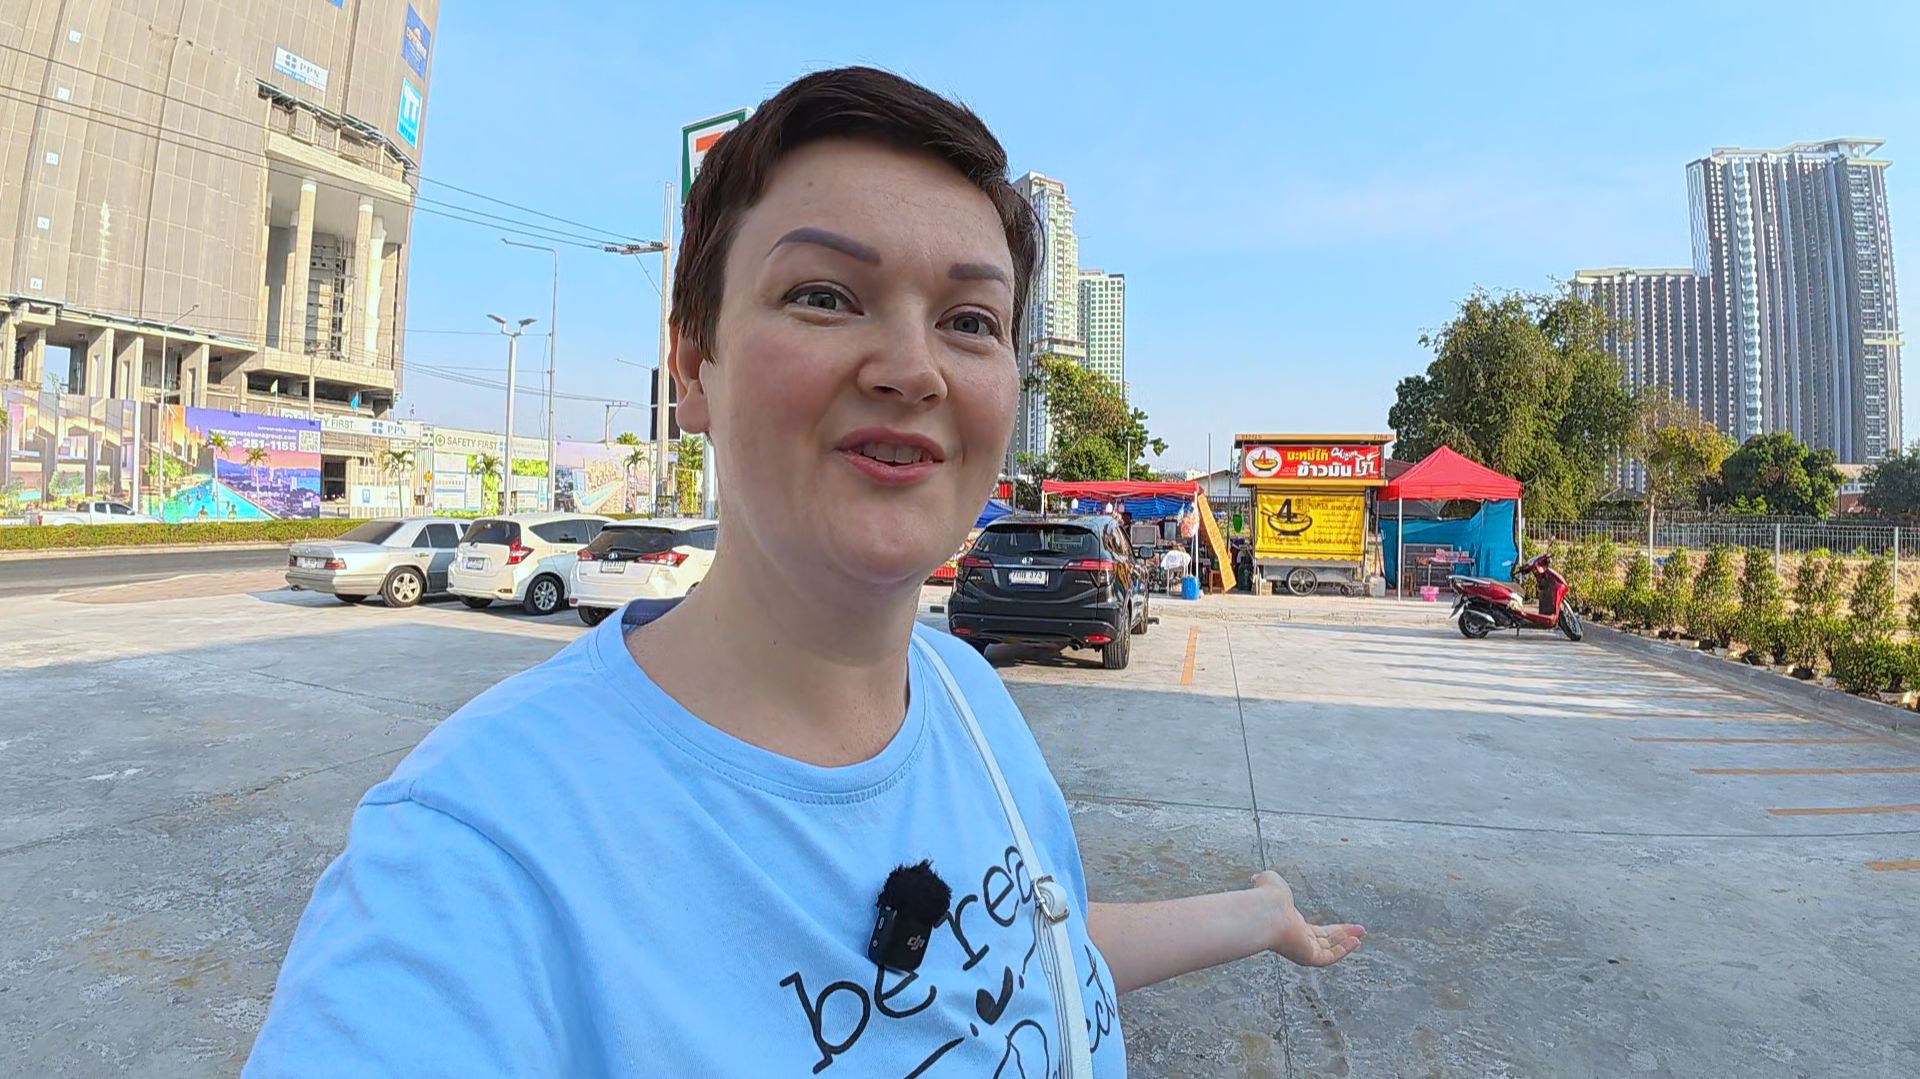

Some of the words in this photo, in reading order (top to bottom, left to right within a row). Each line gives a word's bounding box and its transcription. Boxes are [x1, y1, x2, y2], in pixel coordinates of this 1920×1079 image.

[331, 419, 354, 429] FIRST
[387, 425, 407, 435] PPN
[447, 436, 476, 448] SAFETY
[477, 439, 497, 450] FIRST
